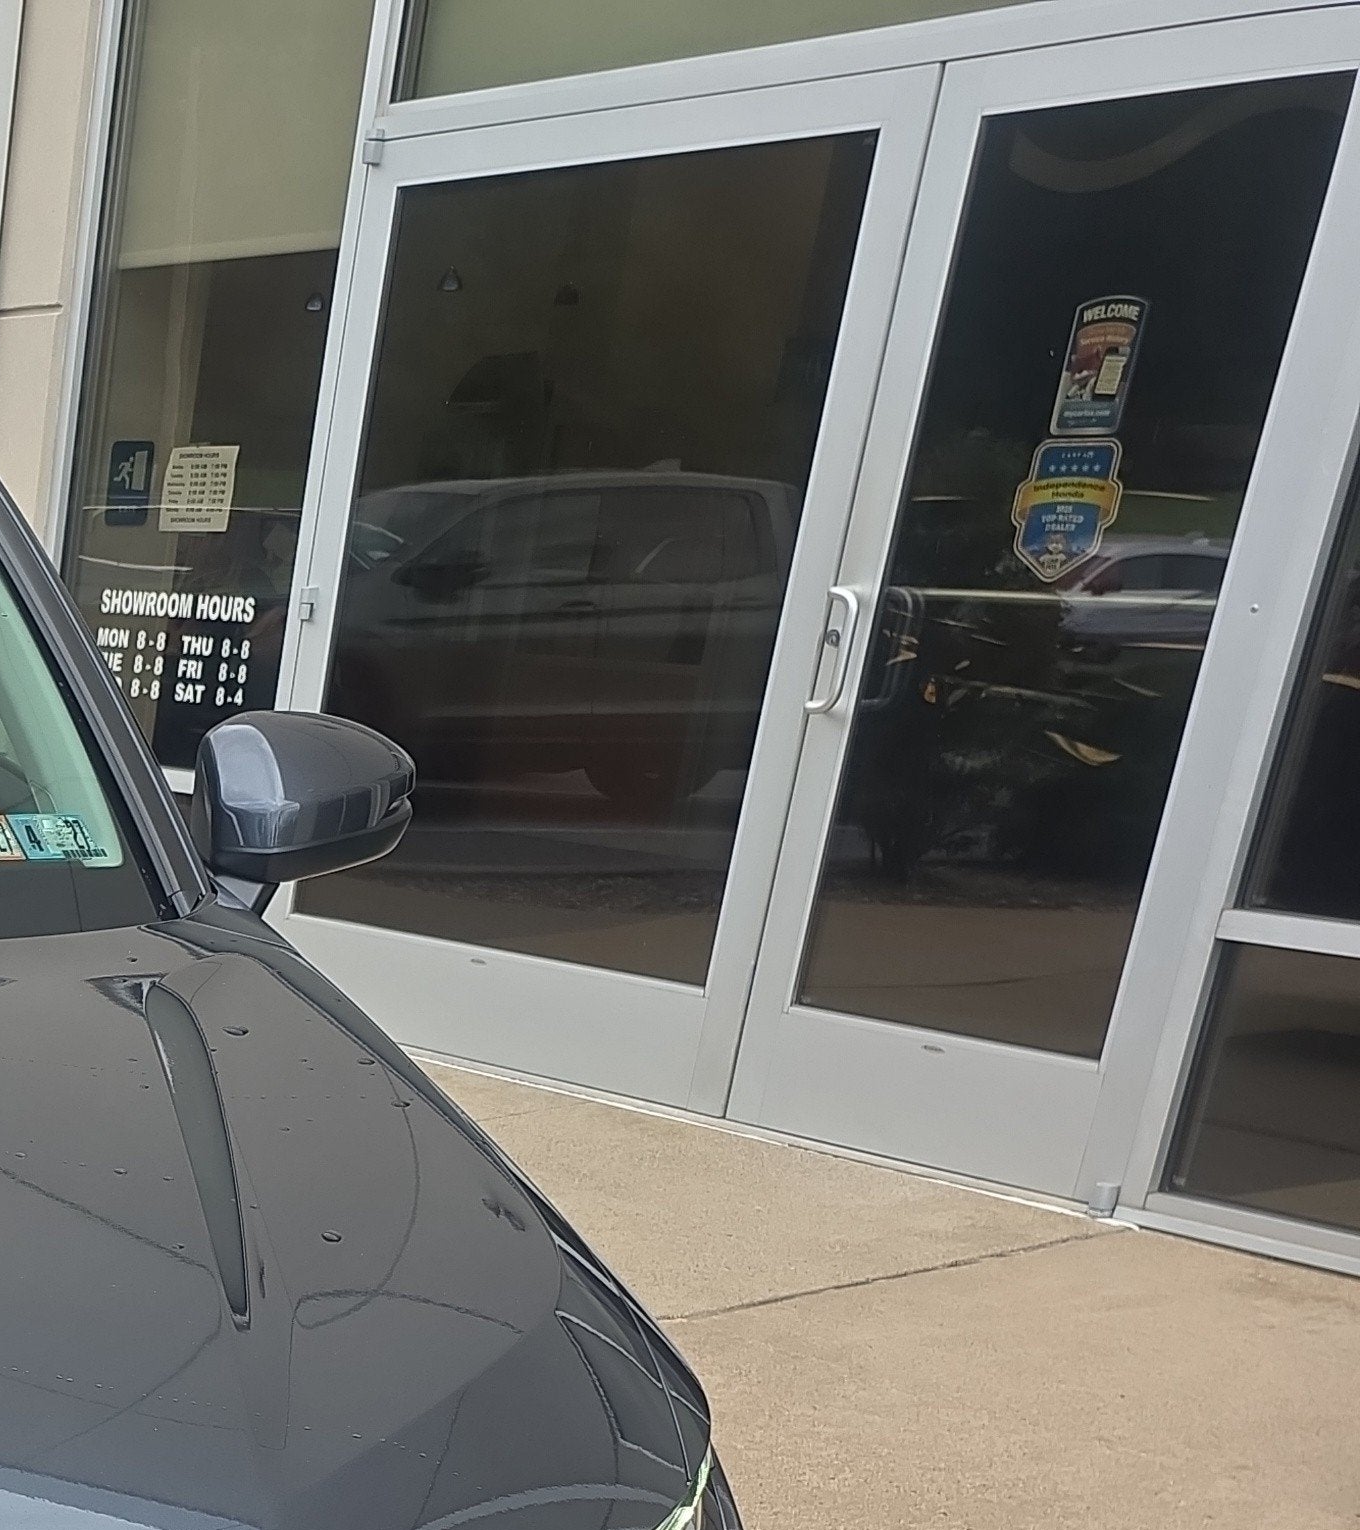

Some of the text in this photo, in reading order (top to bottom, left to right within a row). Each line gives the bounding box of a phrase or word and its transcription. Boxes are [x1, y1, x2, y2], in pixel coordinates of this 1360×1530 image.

[1083, 303, 1141, 322] WELCOME
[100, 588, 256, 623] SHOWROOM HOURS
[96, 627, 130, 648] MON
[181, 634, 214, 656] THU
[102, 651, 124, 672] UE
[177, 659, 203, 680] FRI
[174, 682, 206, 704] SAT
[24, 825, 45, 852] 4
